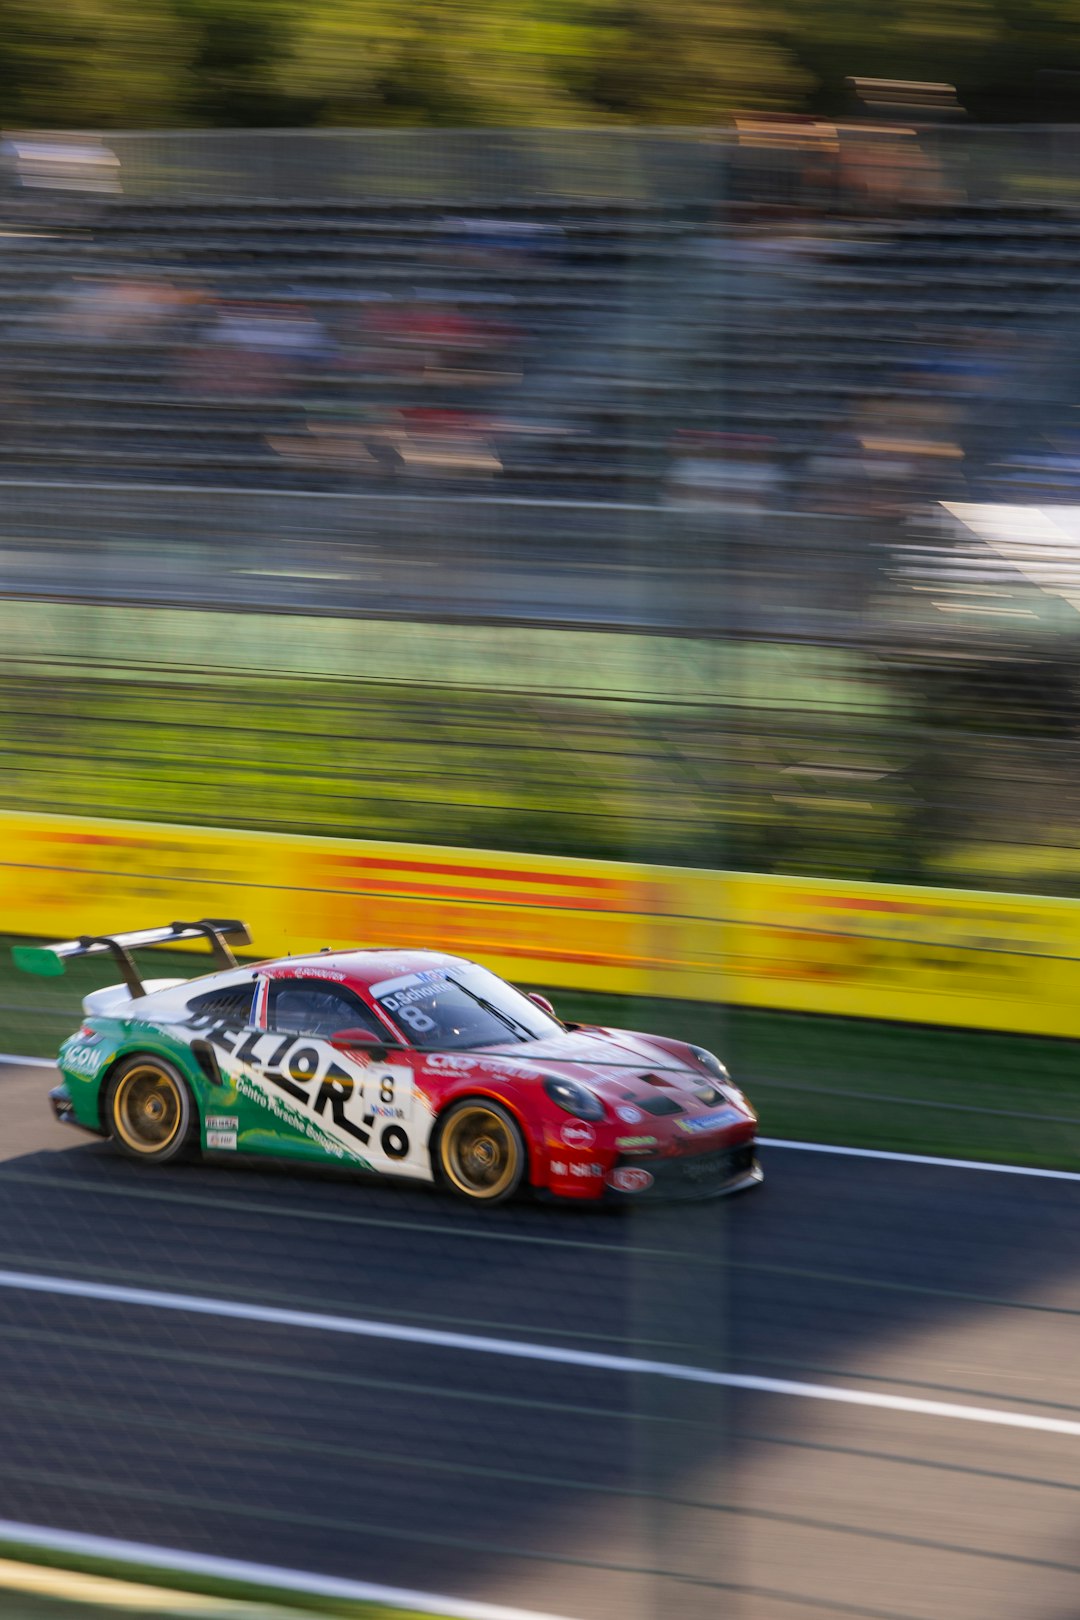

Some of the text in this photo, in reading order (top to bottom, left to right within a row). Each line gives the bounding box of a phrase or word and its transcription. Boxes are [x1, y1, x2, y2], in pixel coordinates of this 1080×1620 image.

[398, 1005, 434, 1032] 8
[380, 1074, 395, 1104] 8
[236, 1075, 267, 1108] Centro
[267, 1094, 305, 1134] Porsche
